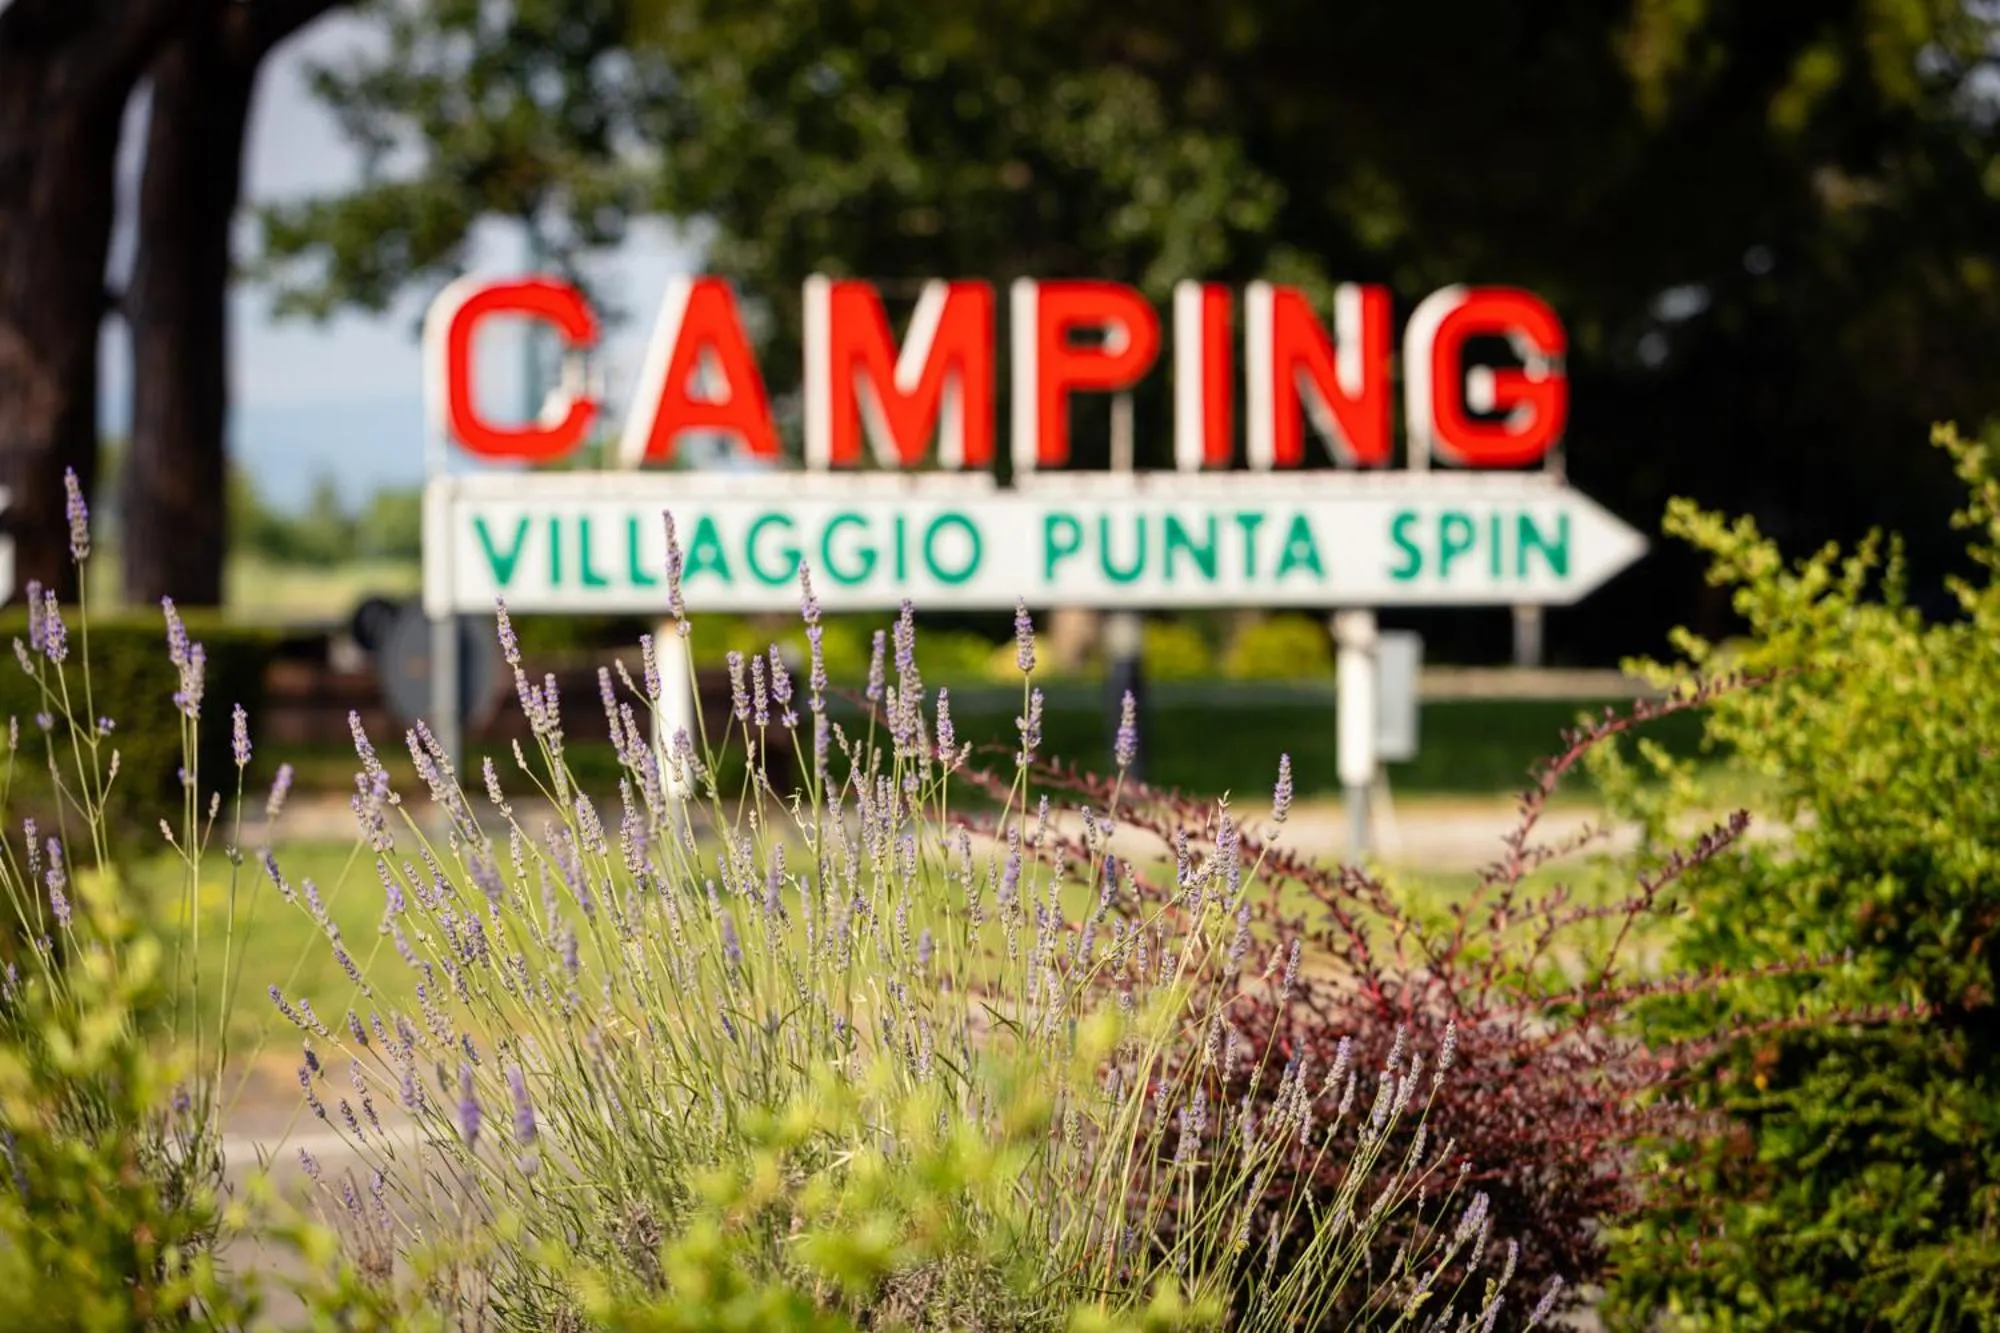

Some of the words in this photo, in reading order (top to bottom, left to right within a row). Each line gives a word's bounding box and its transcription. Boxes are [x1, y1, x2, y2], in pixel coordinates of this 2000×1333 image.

[446, 276, 1567, 466] CAMPING
[472, 511, 985, 588] VILLAGGIO
[1042, 511, 1326, 585] PUNTA
[1389, 510, 1571, 578] SPIN
